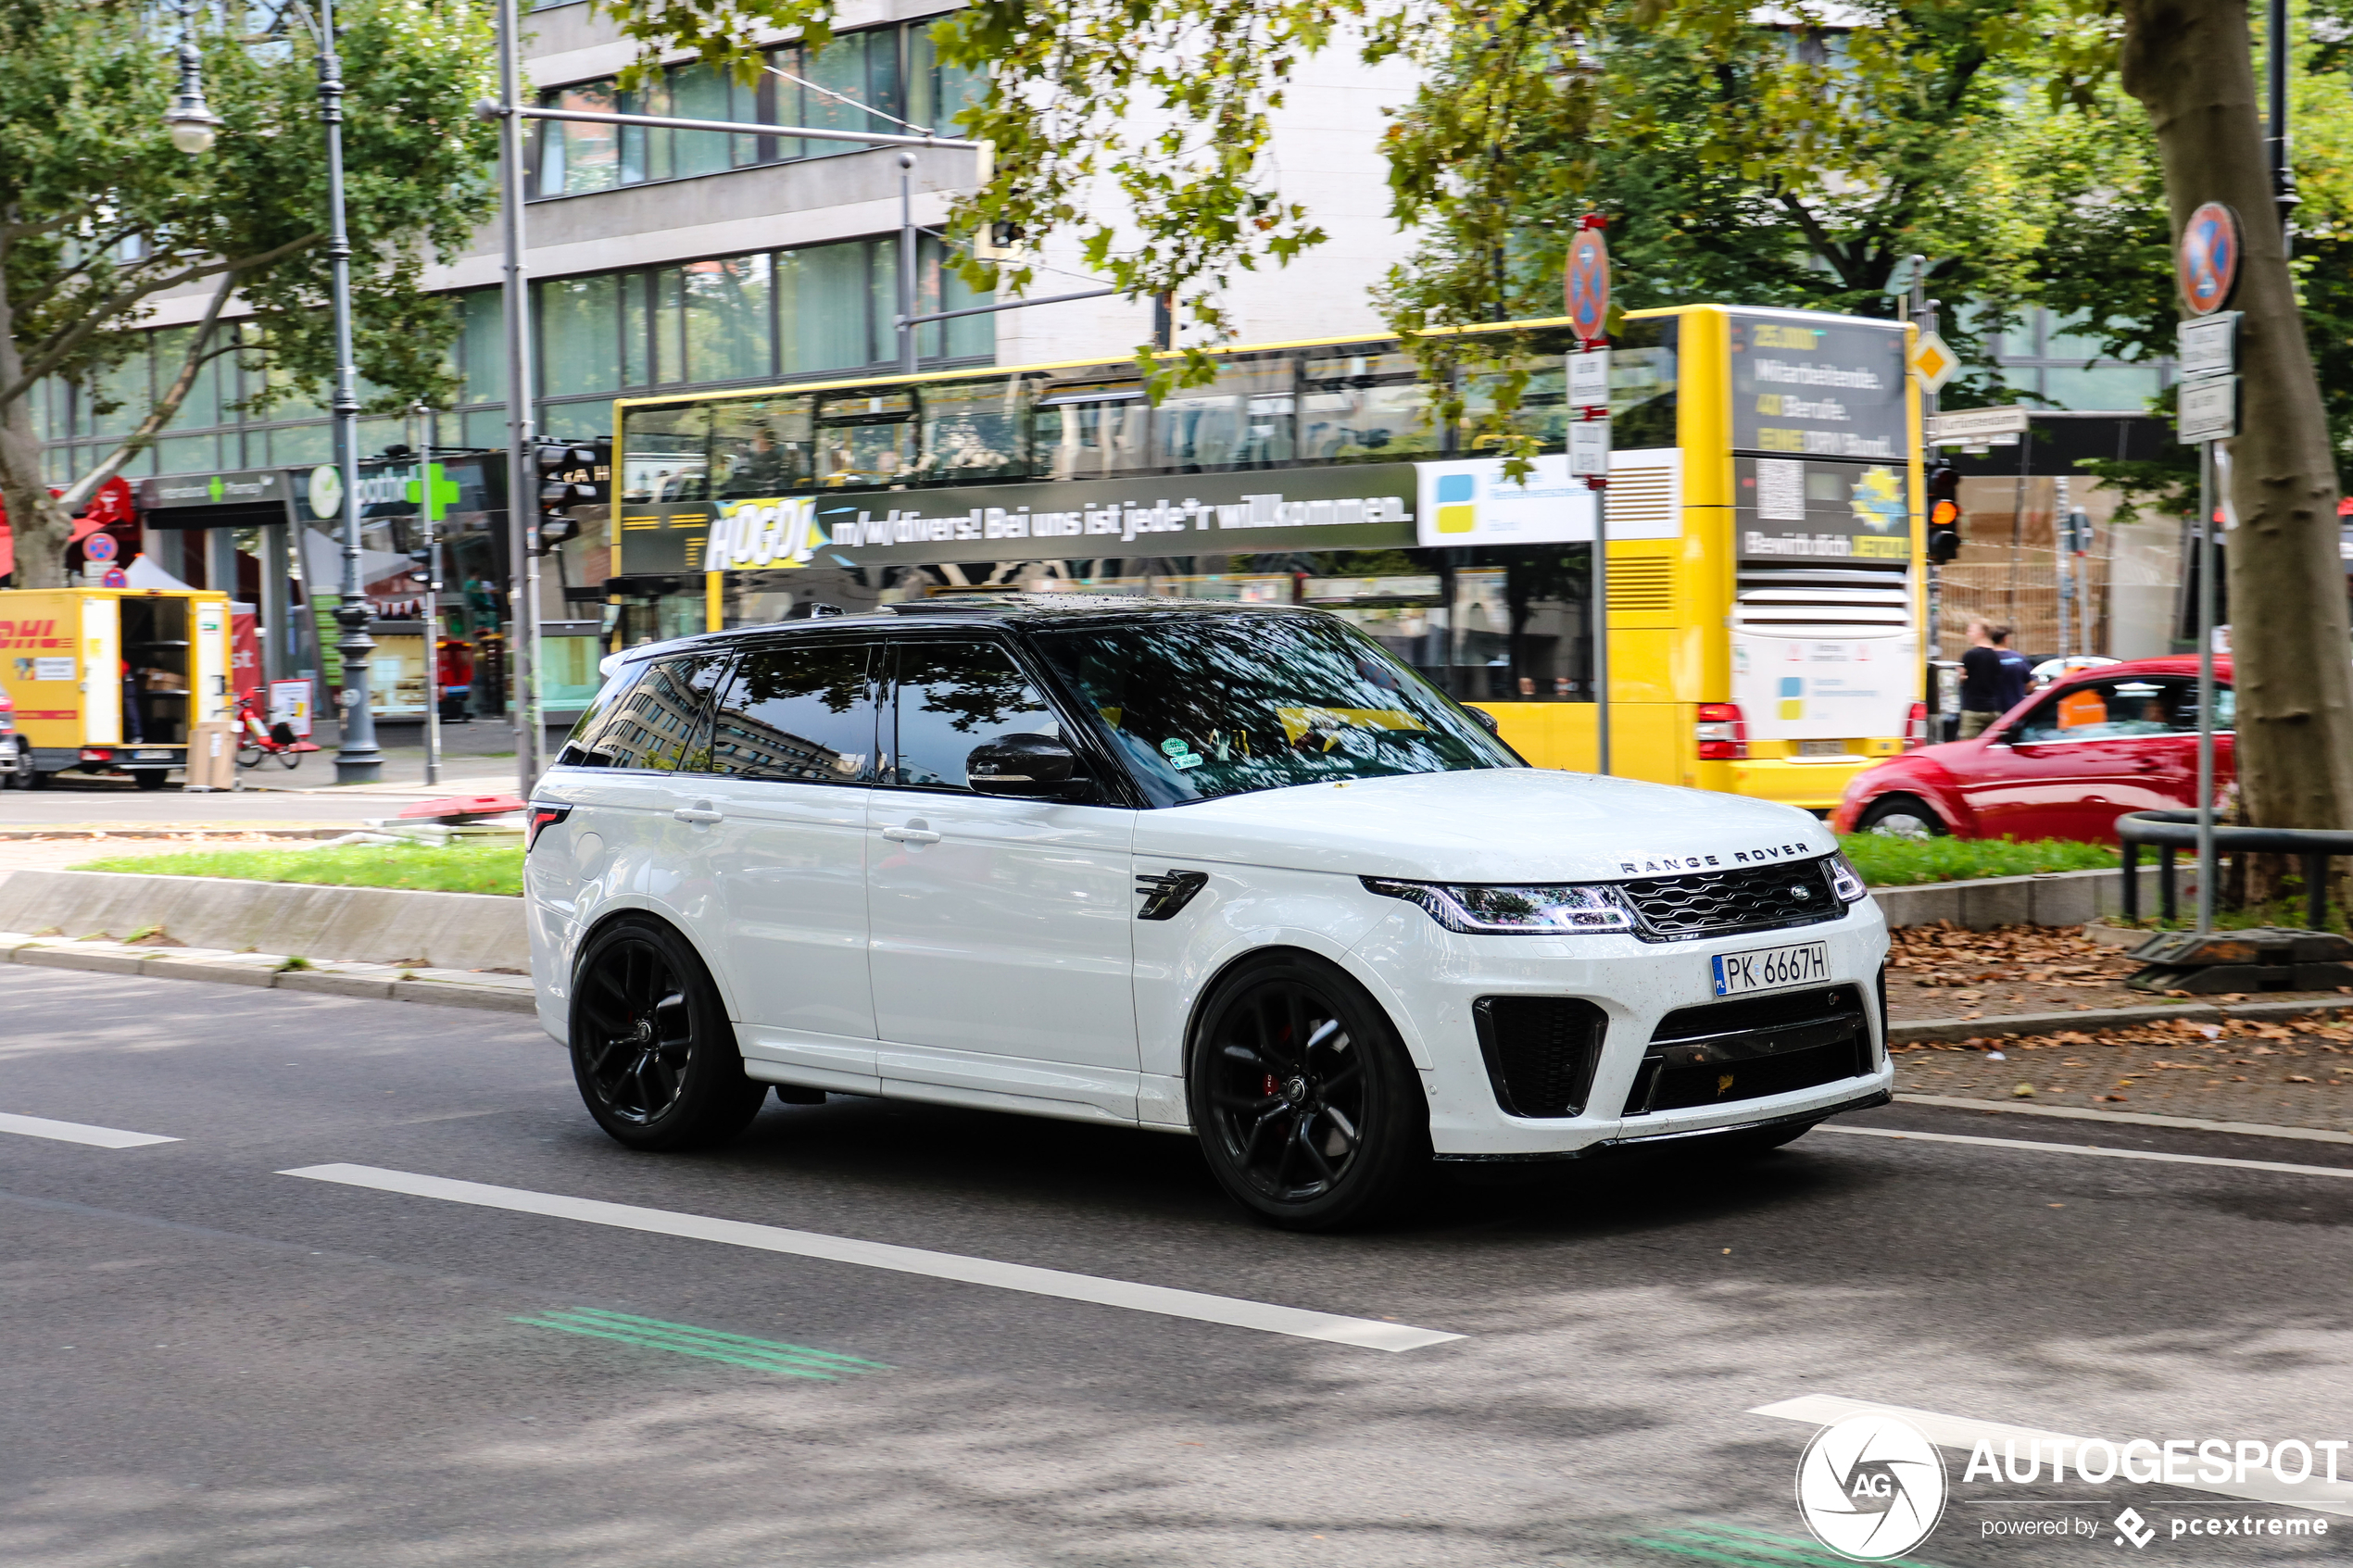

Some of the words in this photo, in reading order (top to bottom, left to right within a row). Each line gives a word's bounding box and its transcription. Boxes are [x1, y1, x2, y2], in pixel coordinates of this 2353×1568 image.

[984, 506, 1030, 539] Bei
[1031, 511, 1083, 537] uns
[1084, 502, 1122, 535] ist
[1215, 493, 1415, 531] willkommen.
[1620, 855, 1720, 874] RANGE
[1734, 842, 1809, 863] ROVER
[1716, 979, 1725, 989] PL
[1727, 955, 1756, 990] PK
[1764, 946, 1825, 984] 6667H
